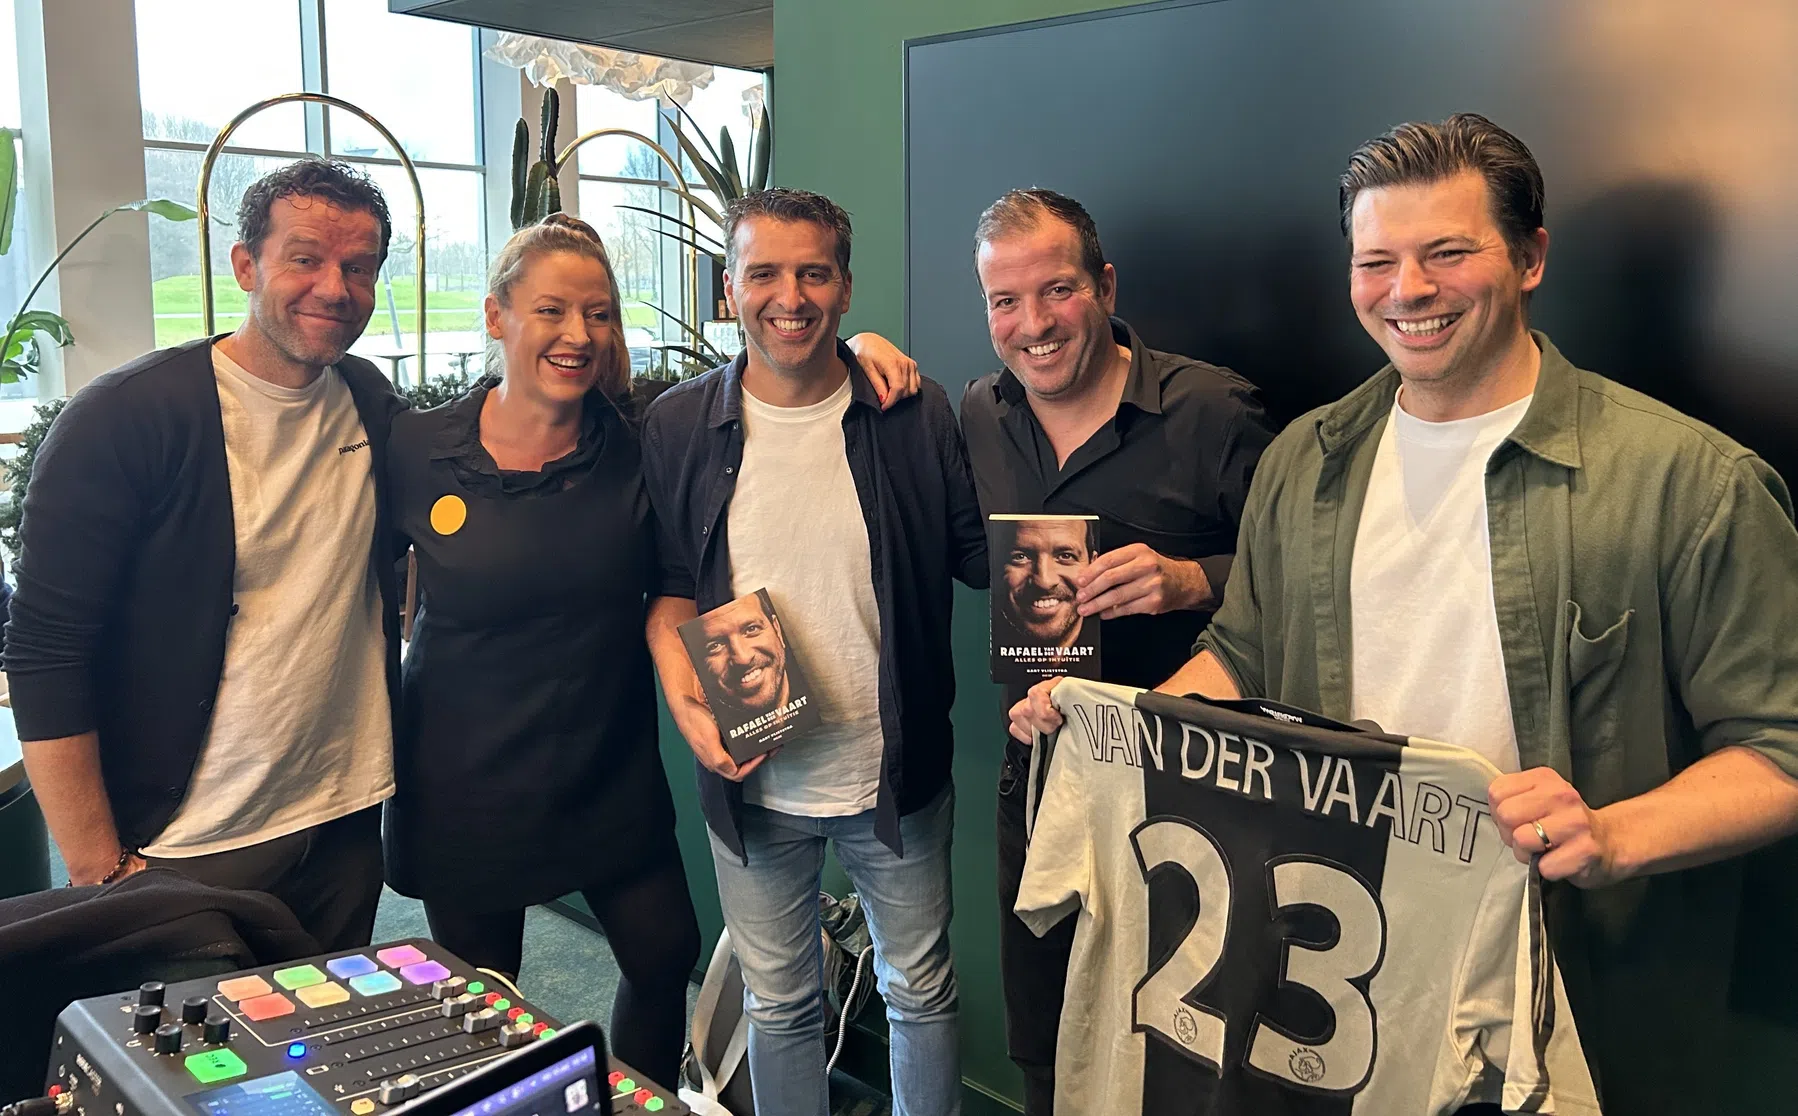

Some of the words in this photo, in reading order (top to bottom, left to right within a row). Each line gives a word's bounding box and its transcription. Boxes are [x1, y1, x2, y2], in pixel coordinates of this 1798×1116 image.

[1000, 646, 1043, 656] RAFAEL
[1055, 646, 1094, 656] VAART
[729, 715, 768, 738] RAFAEL
[774, 695, 808, 717] VAART
[745, 727, 763, 739] ALLES
[763, 722, 773, 730] OP
[1073, 703, 1164, 772] VAN
[1178, 721, 1272, 799] DER
[1129, 814, 1388, 1097] 23
[1173, 1007, 1187, 1019] AJAX
[1289, 1046, 1310, 1061] AJAX
